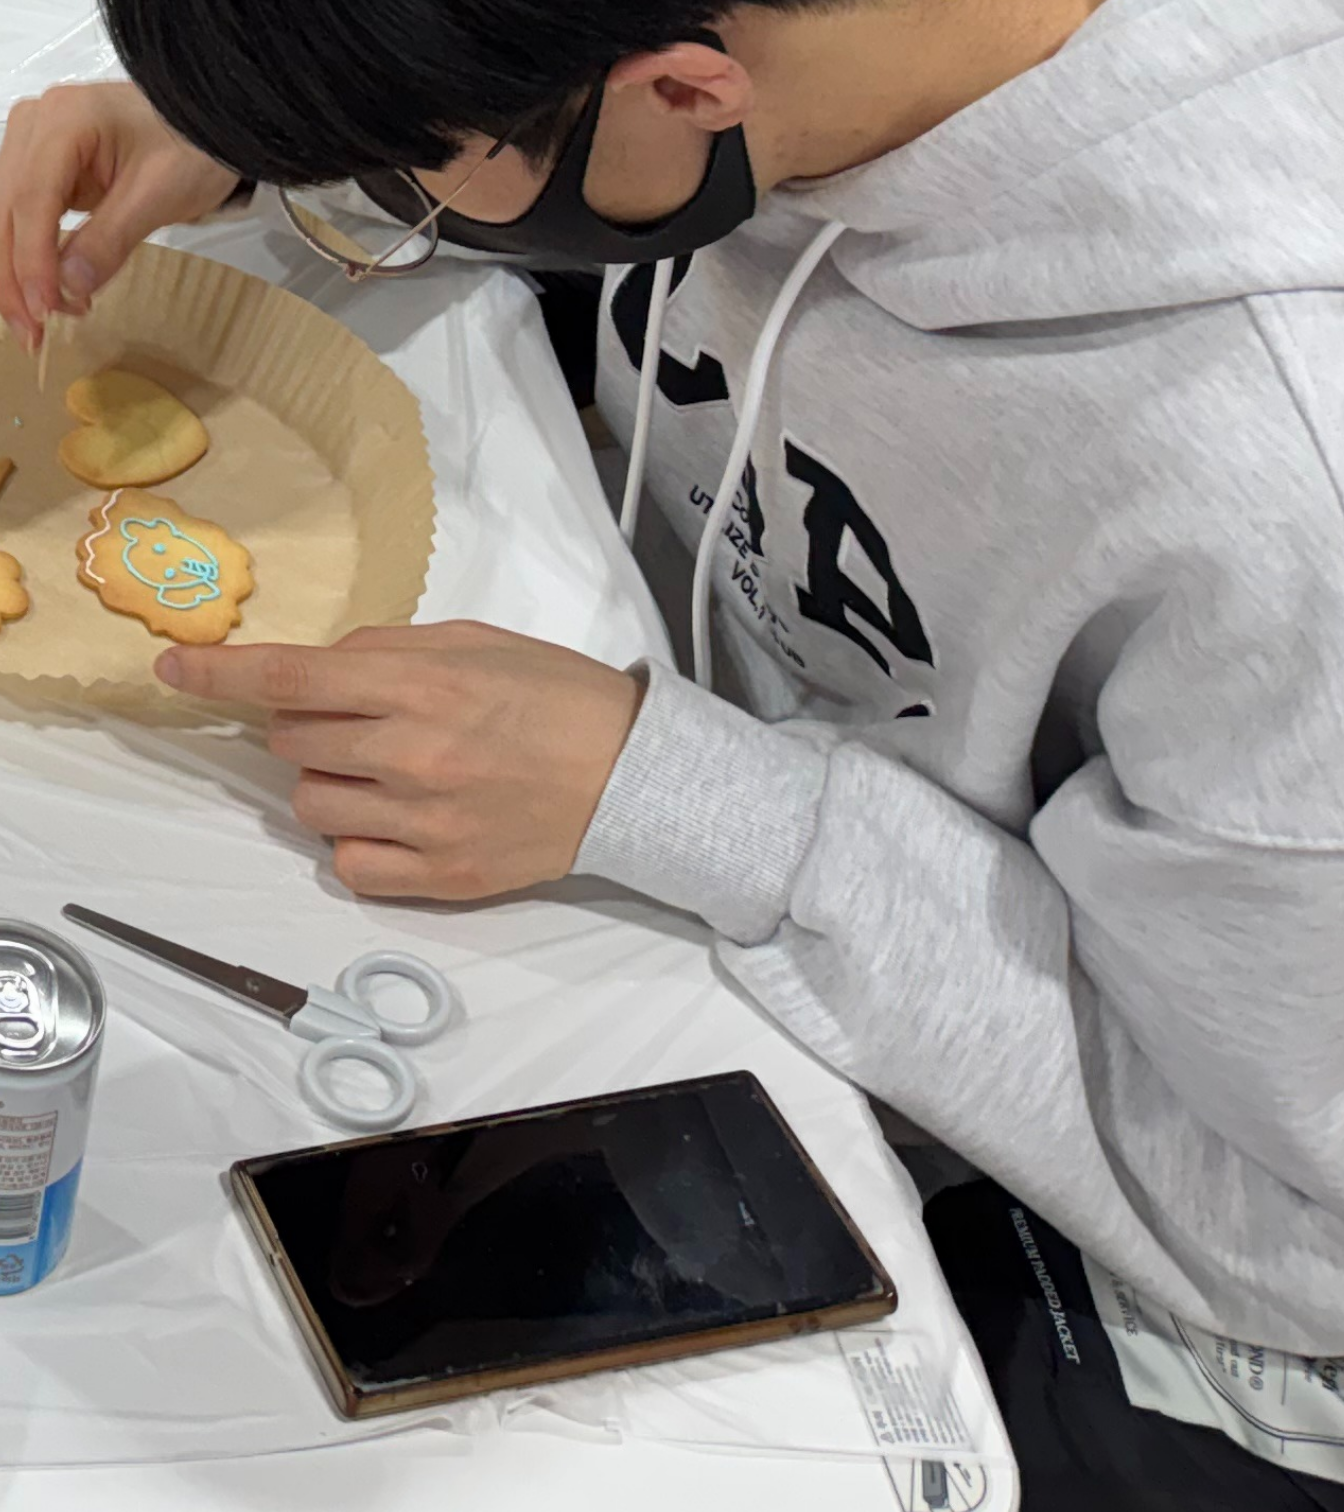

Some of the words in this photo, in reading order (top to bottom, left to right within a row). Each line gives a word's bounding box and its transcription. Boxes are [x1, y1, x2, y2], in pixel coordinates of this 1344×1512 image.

[1009, 1207, 1041, 1259] PREMIUM
[1031, 1259, 1062, 1309] PADDED
[1049, 1308, 1081, 1365] JACKET
